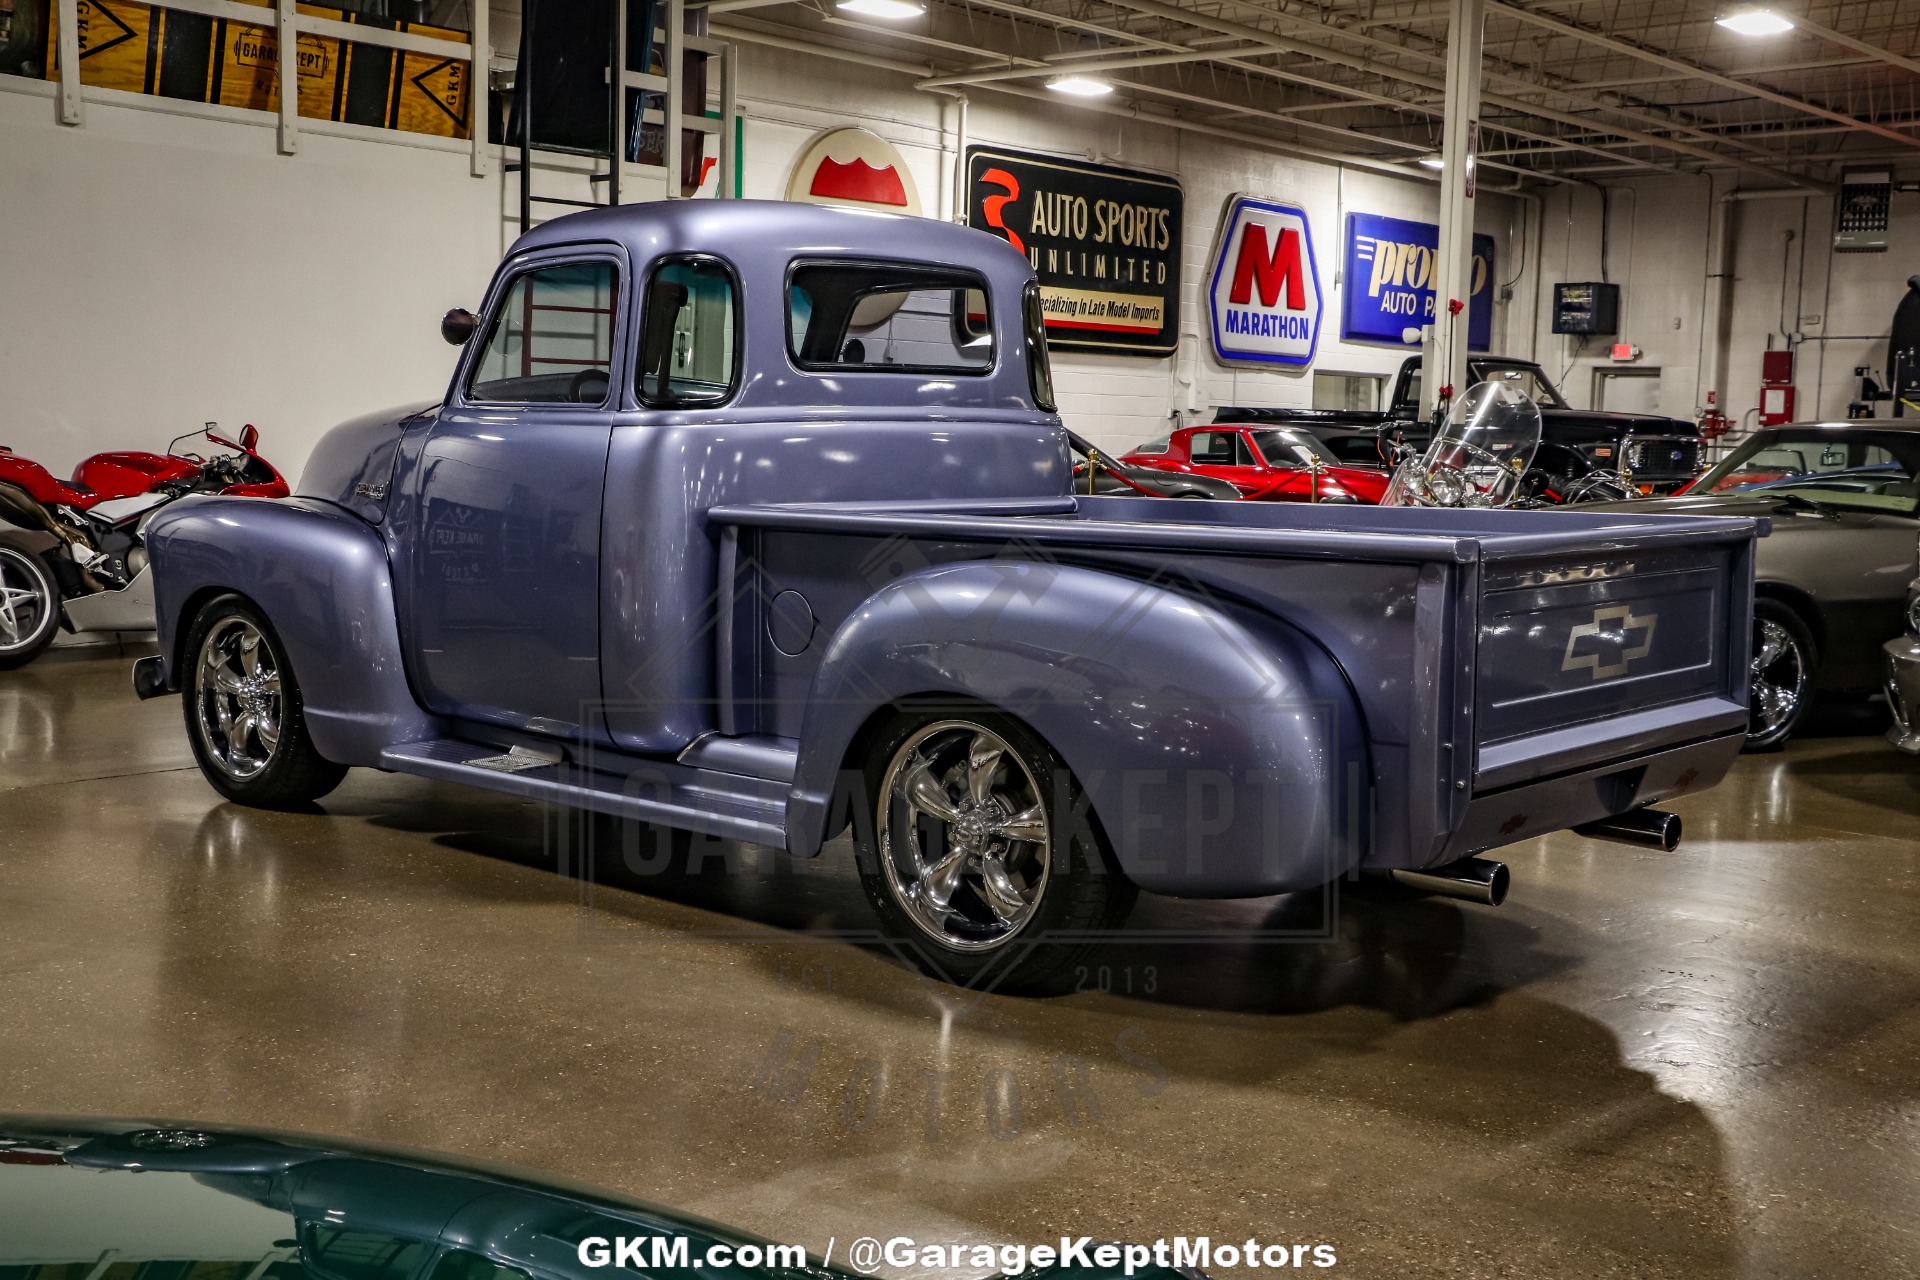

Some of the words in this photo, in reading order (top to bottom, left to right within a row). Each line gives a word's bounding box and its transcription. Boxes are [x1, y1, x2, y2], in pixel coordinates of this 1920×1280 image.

[243, 42, 278, 62] GARA
[297, 52, 321, 69] EPT
[256, 79, 303, 96] MOTS
[446, 65, 460, 105] GKM
[1031, 190, 1088, 240] AUTO
[1094, 199, 1170, 250] SPORTS
[1030, 246, 1166, 285] UNLIMITED
[1229, 221, 1306, 311] M
[1368, 239, 1487, 297] proo
[1040, 294, 1077, 316] ecializing
[1078, 297, 1087, 315] In
[1088, 299, 1105, 316] Late
[1106, 300, 1130, 318] Model
[1131, 303, 1160, 322] Imports
[1381, 290, 1417, 315] AUTO
[1225, 309, 1309, 340] MARATHON
